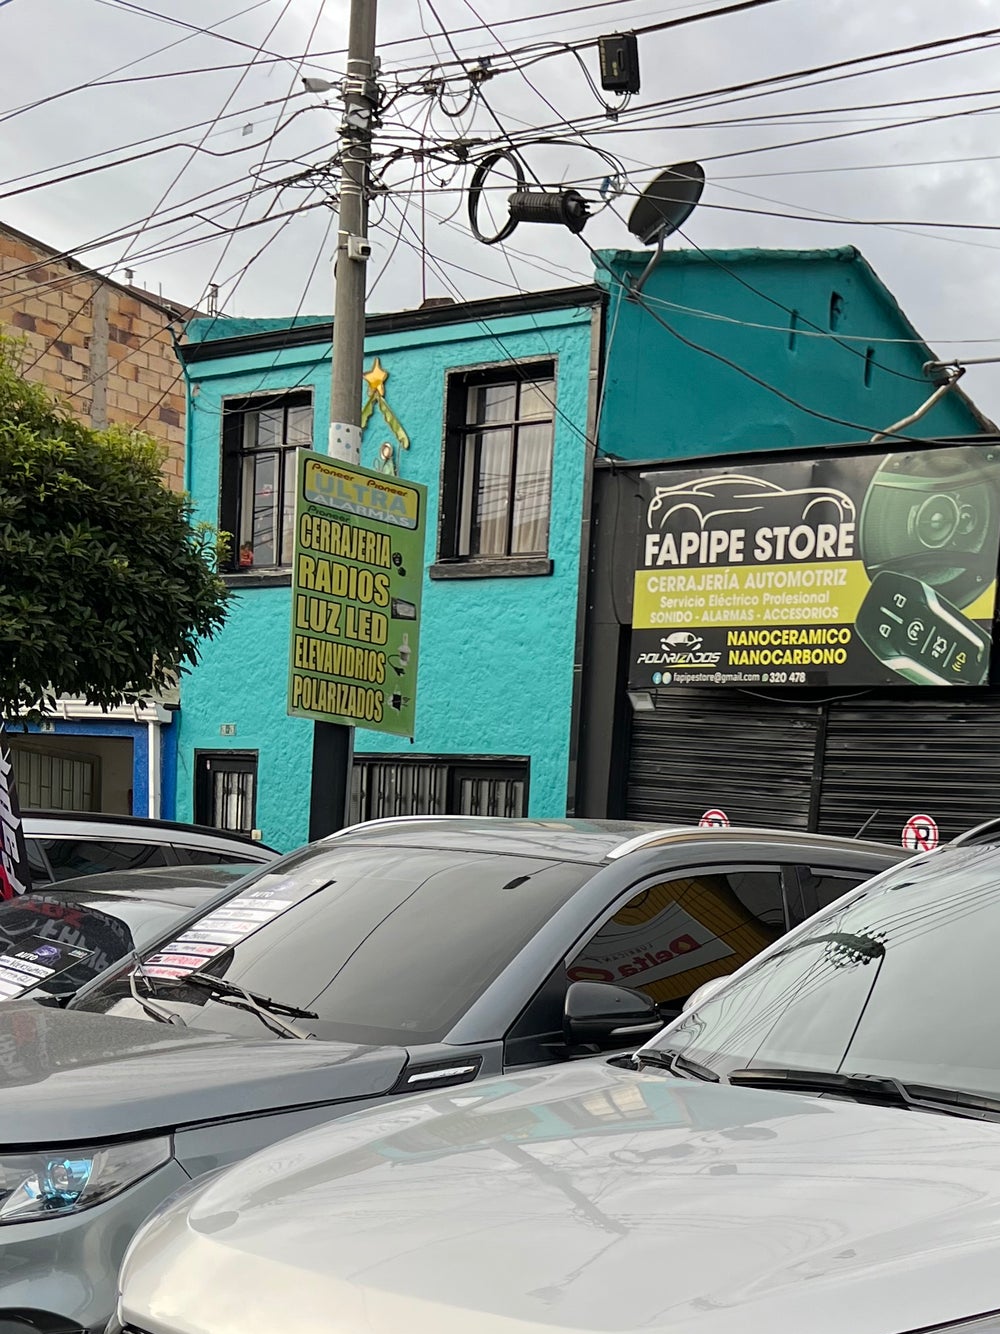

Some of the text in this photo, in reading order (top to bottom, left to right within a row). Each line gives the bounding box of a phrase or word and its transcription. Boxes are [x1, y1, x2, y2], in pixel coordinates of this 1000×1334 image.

[312, 463, 408, 497] Pioneer Pioneer
[315, 473, 407, 514] ULTRA
[311, 494, 410, 527] ALARMAS
[300, 513, 391, 568] CERRAJERIA
[645, 523, 855, 566] FAPIPE STORE
[298, 553, 390, 607] RADIOS
[647, 568, 847, 593] CERRAJERÍA AUTOMOTRIZ
[650, 610, 693, 624] SONIDO
[701, 608, 754, 623] ALARMAS
[763, 606, 838, 621] ACCESORIOS
[660, 590, 829, 609] Servicio Eléctrico Profesional
[296, 594, 388, 645] LUZ LED
[727, 628, 851, 646] NANOCERAMICO
[294, 634, 386, 684] ELEVAVIDRIOS
[637, 652, 721, 664] POLARIZADOS
[728, 648, 847, 666] NANOCARBONO
[673, 672, 807, 684] fapipestore@gmail.com 320 478
[292, 674, 384, 722] POLARIZADOS
